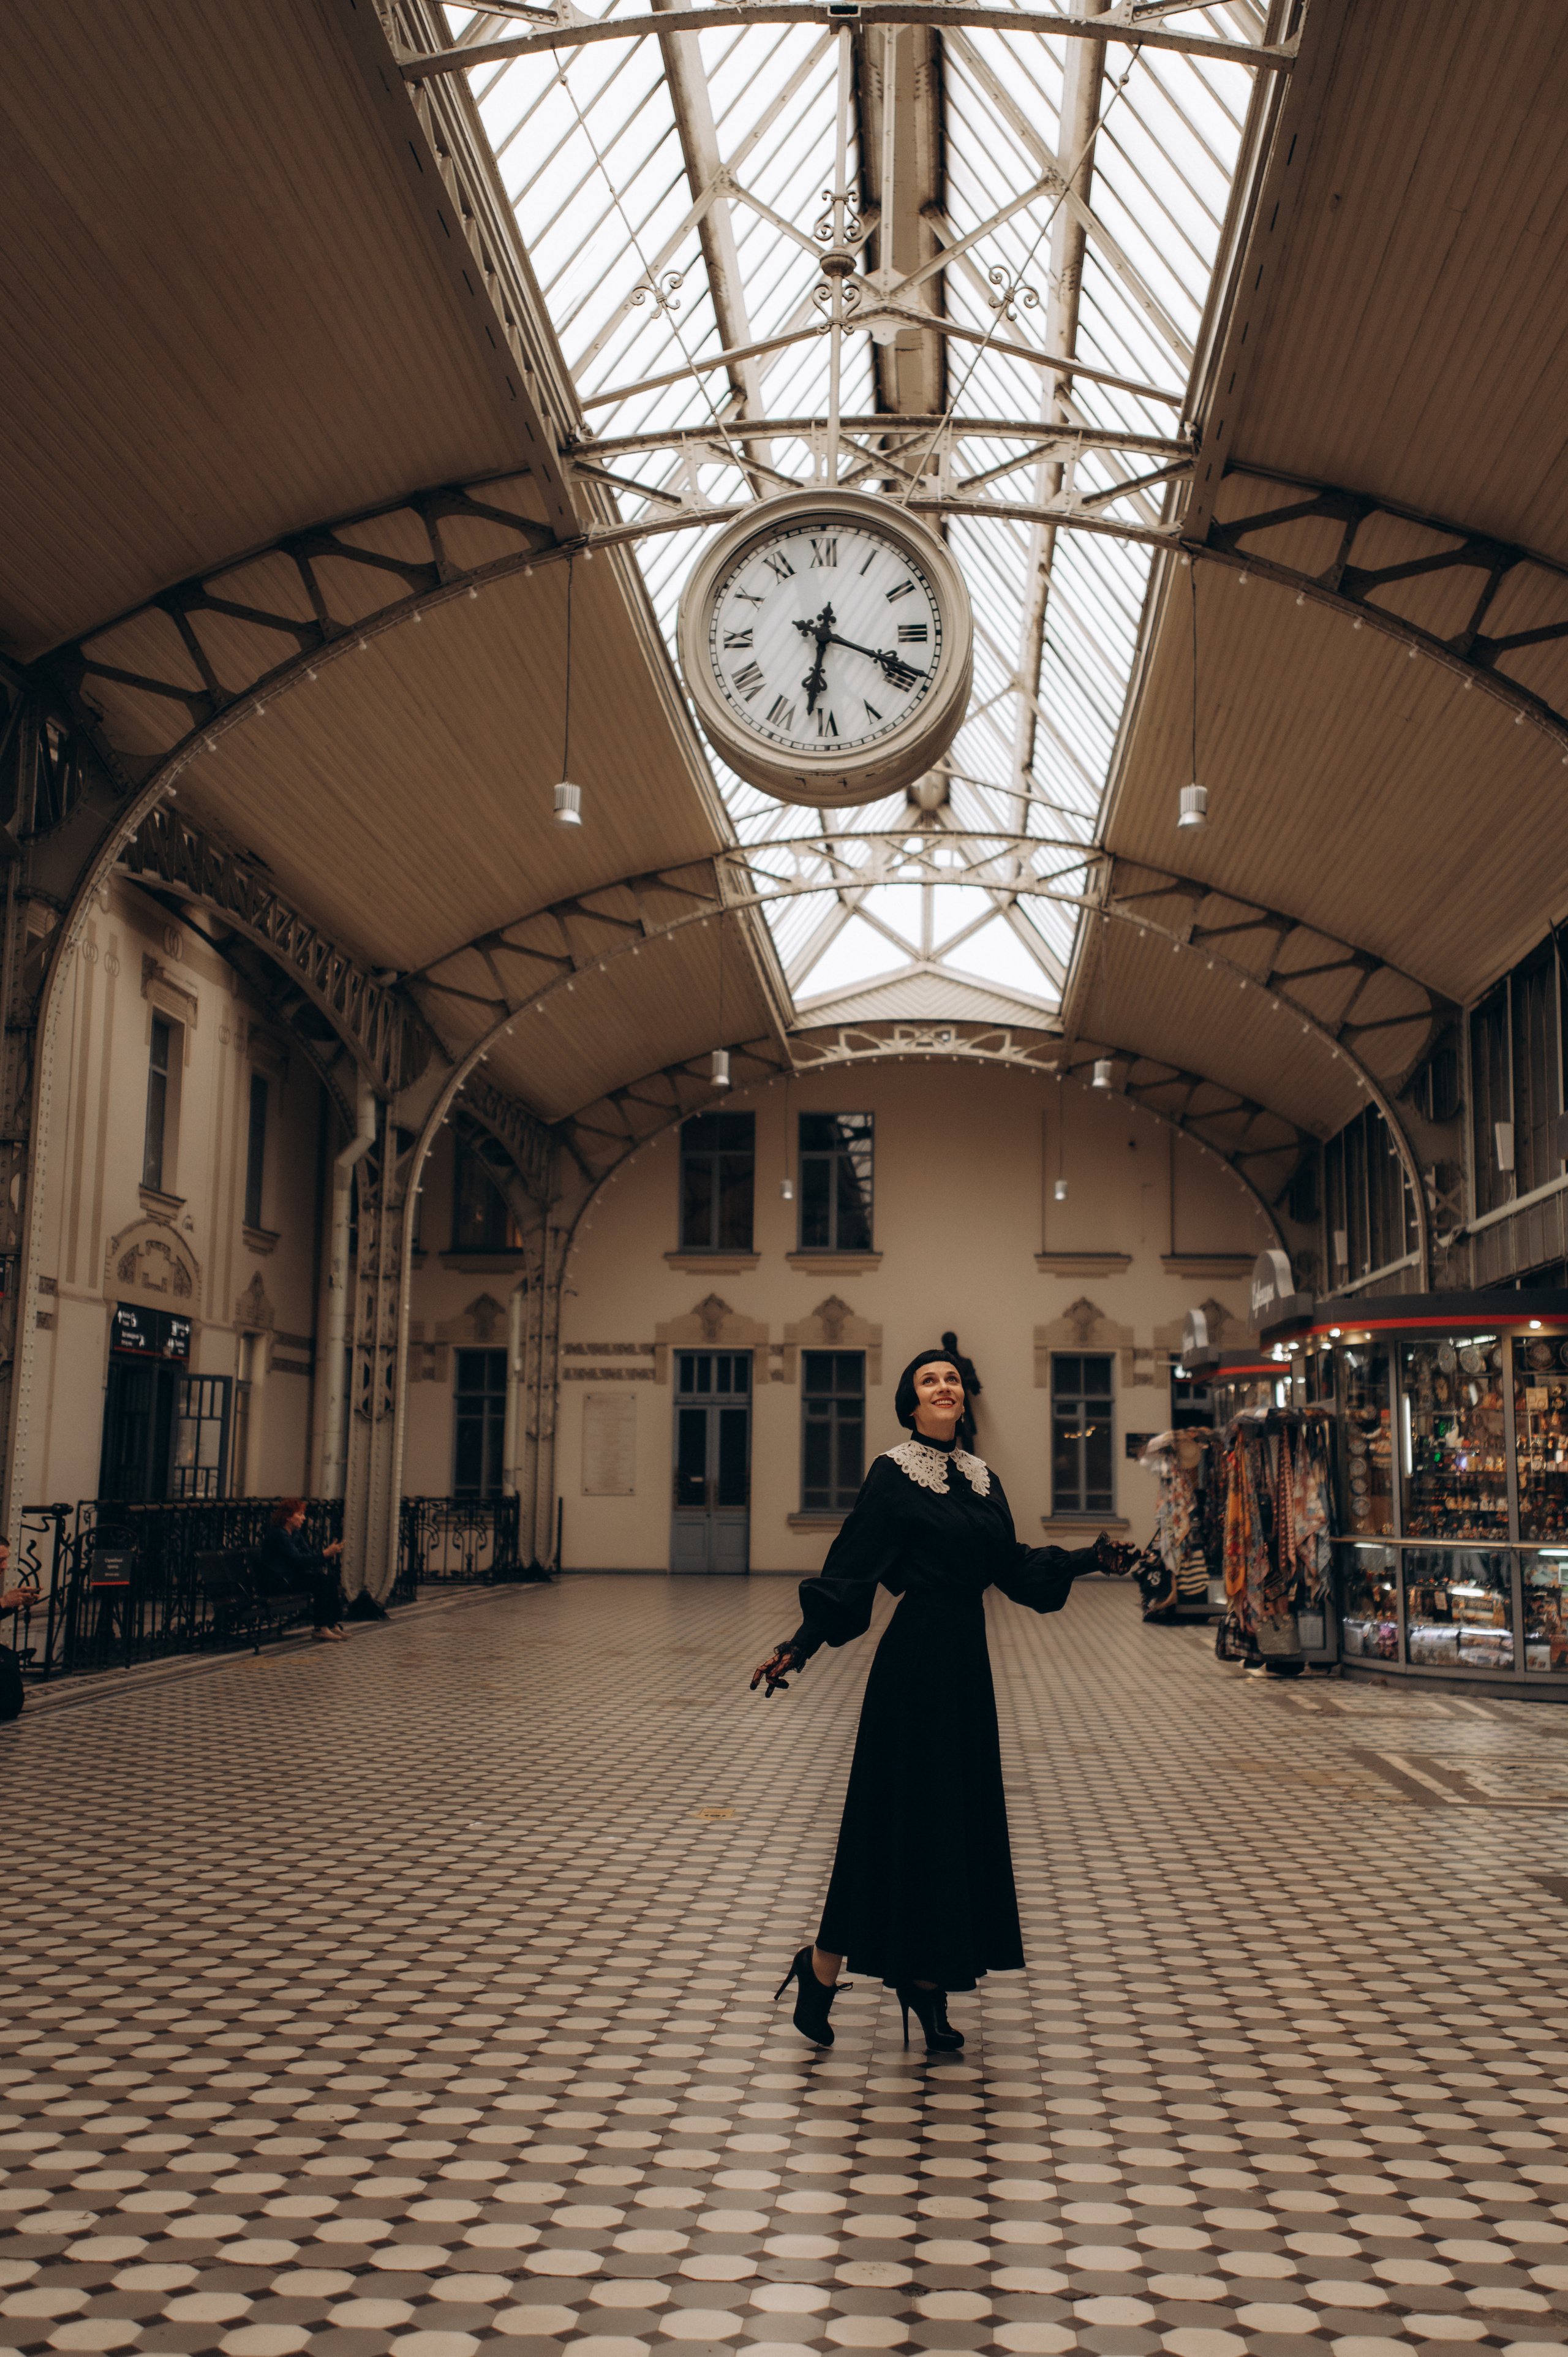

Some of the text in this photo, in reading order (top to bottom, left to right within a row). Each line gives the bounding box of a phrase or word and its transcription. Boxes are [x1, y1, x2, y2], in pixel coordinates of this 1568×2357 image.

[761, 549, 797, 586] XI
[809, 538, 838, 569] XII
[857, 548, 879, 577] I
[733, 583, 767, 612] X
[883, 578, 917, 606] II
[723, 627, 754, 651] IX
[897, 621, 928, 645] III
[730, 659, 767, 705] VIII
[765, 692, 797, 732] VII
[816, 708, 841, 737] VI
[862, 698, 884, 725] V
